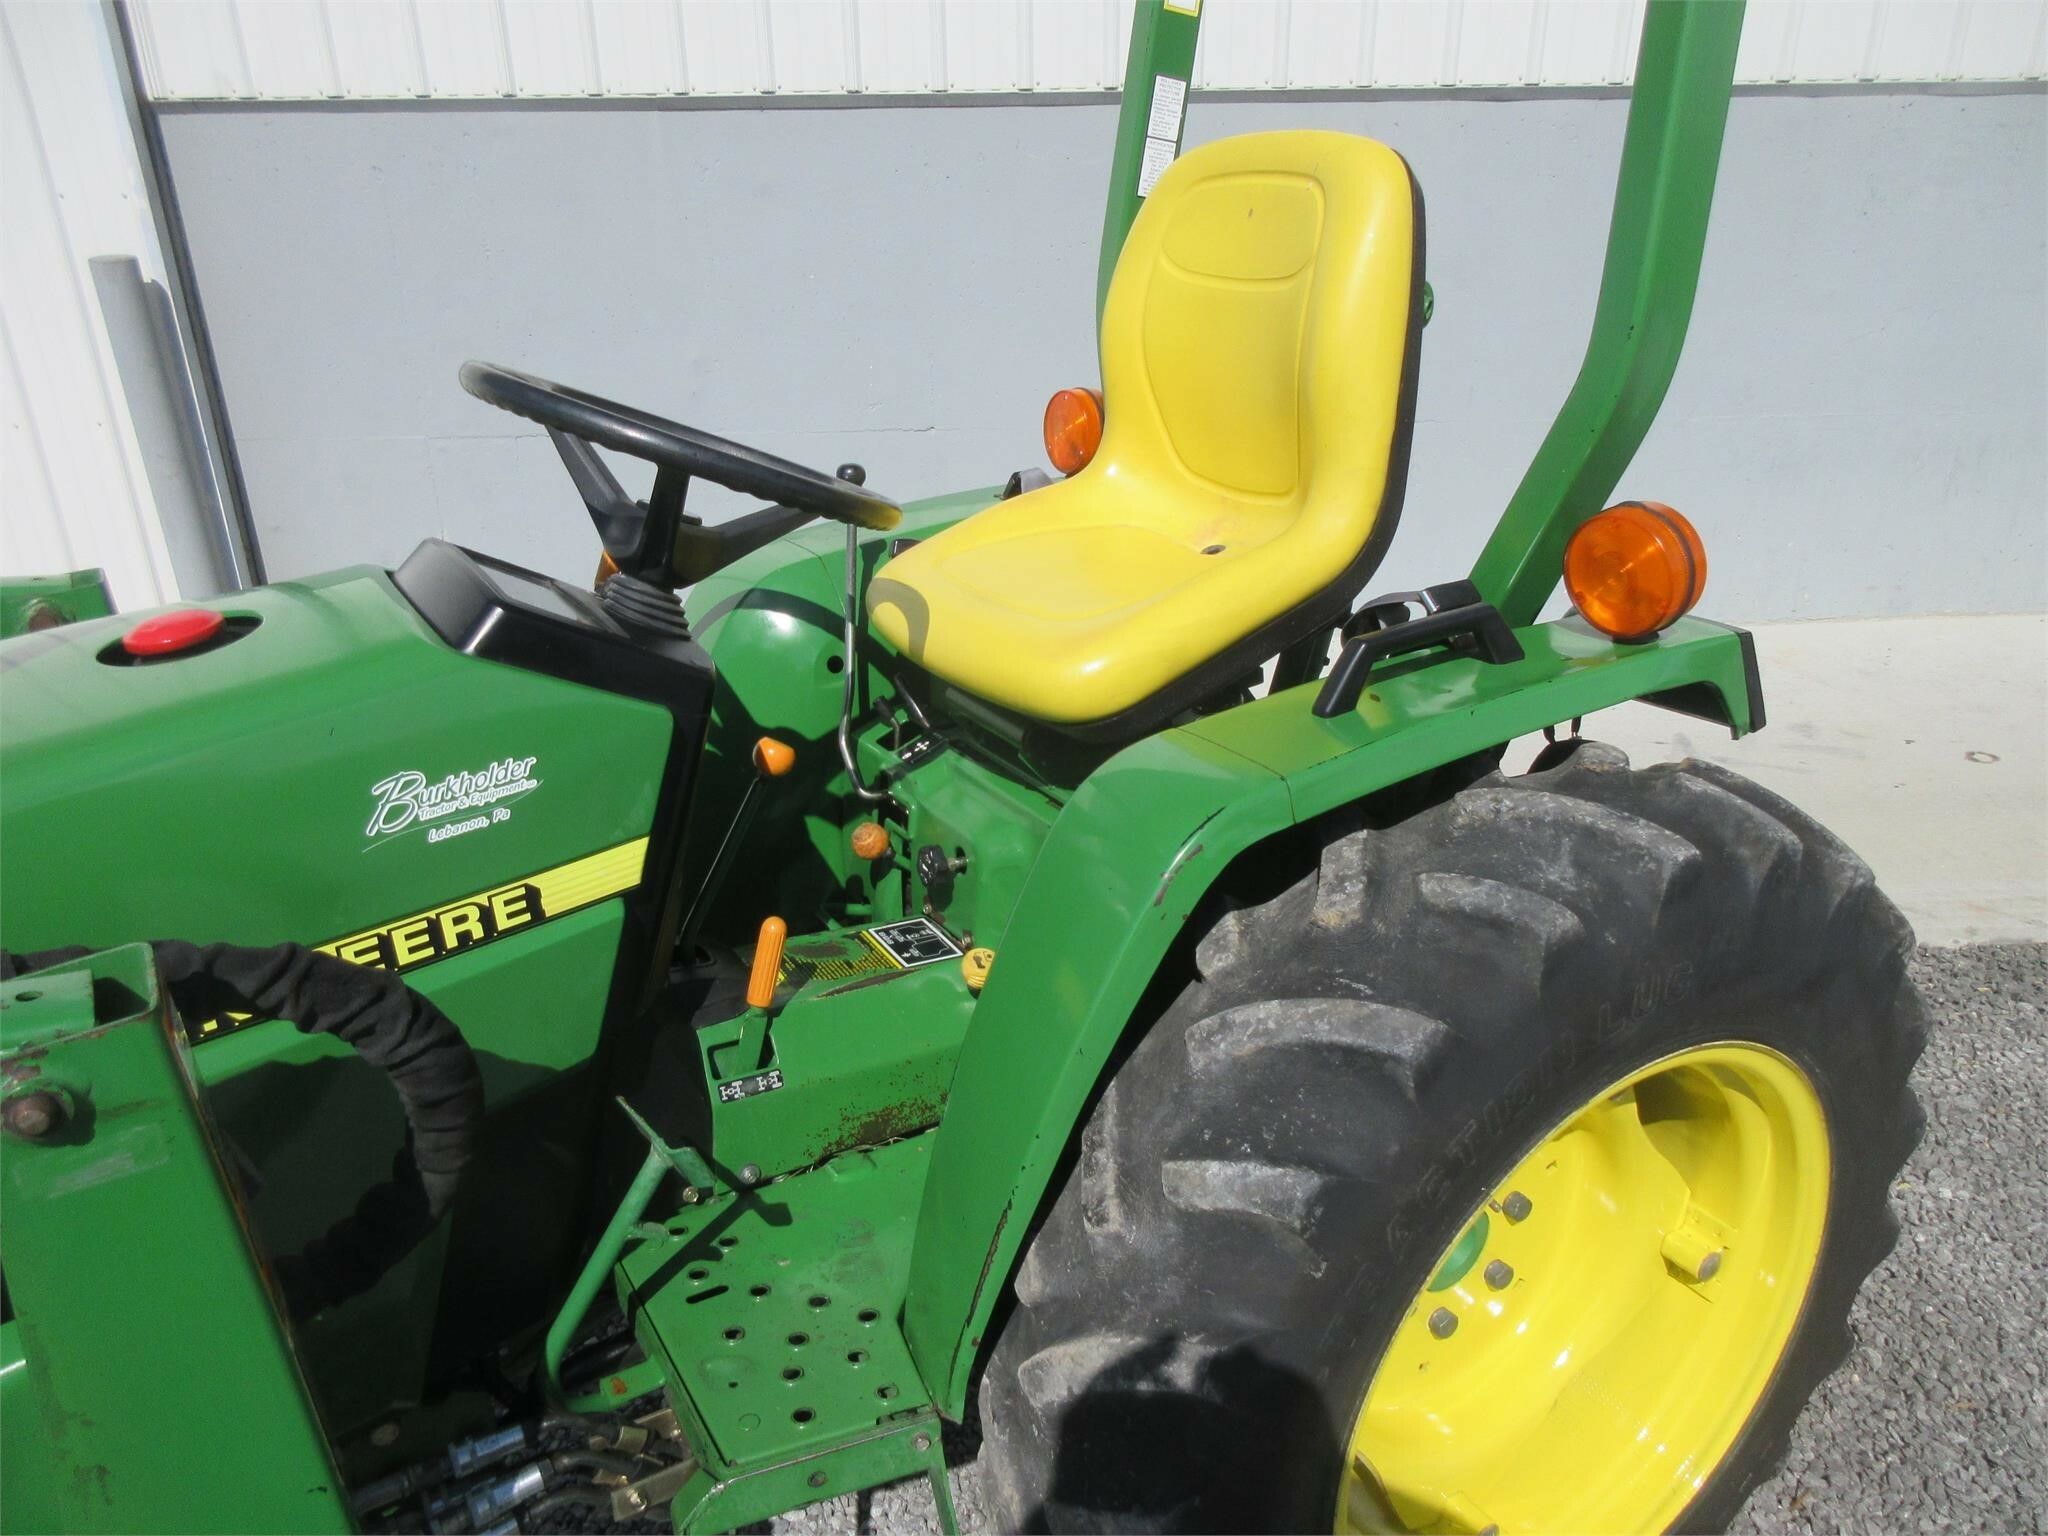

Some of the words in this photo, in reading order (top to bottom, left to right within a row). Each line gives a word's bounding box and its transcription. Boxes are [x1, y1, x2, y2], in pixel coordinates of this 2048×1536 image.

[366, 757, 537, 836] Burkholder
[418, 800, 457, 821] Tractor
[458, 796, 470, 809] &
[469, 778, 527, 806] Equipment
[428, 816, 490, 843] Lebanon,
[493, 808, 511, 823] Pa
